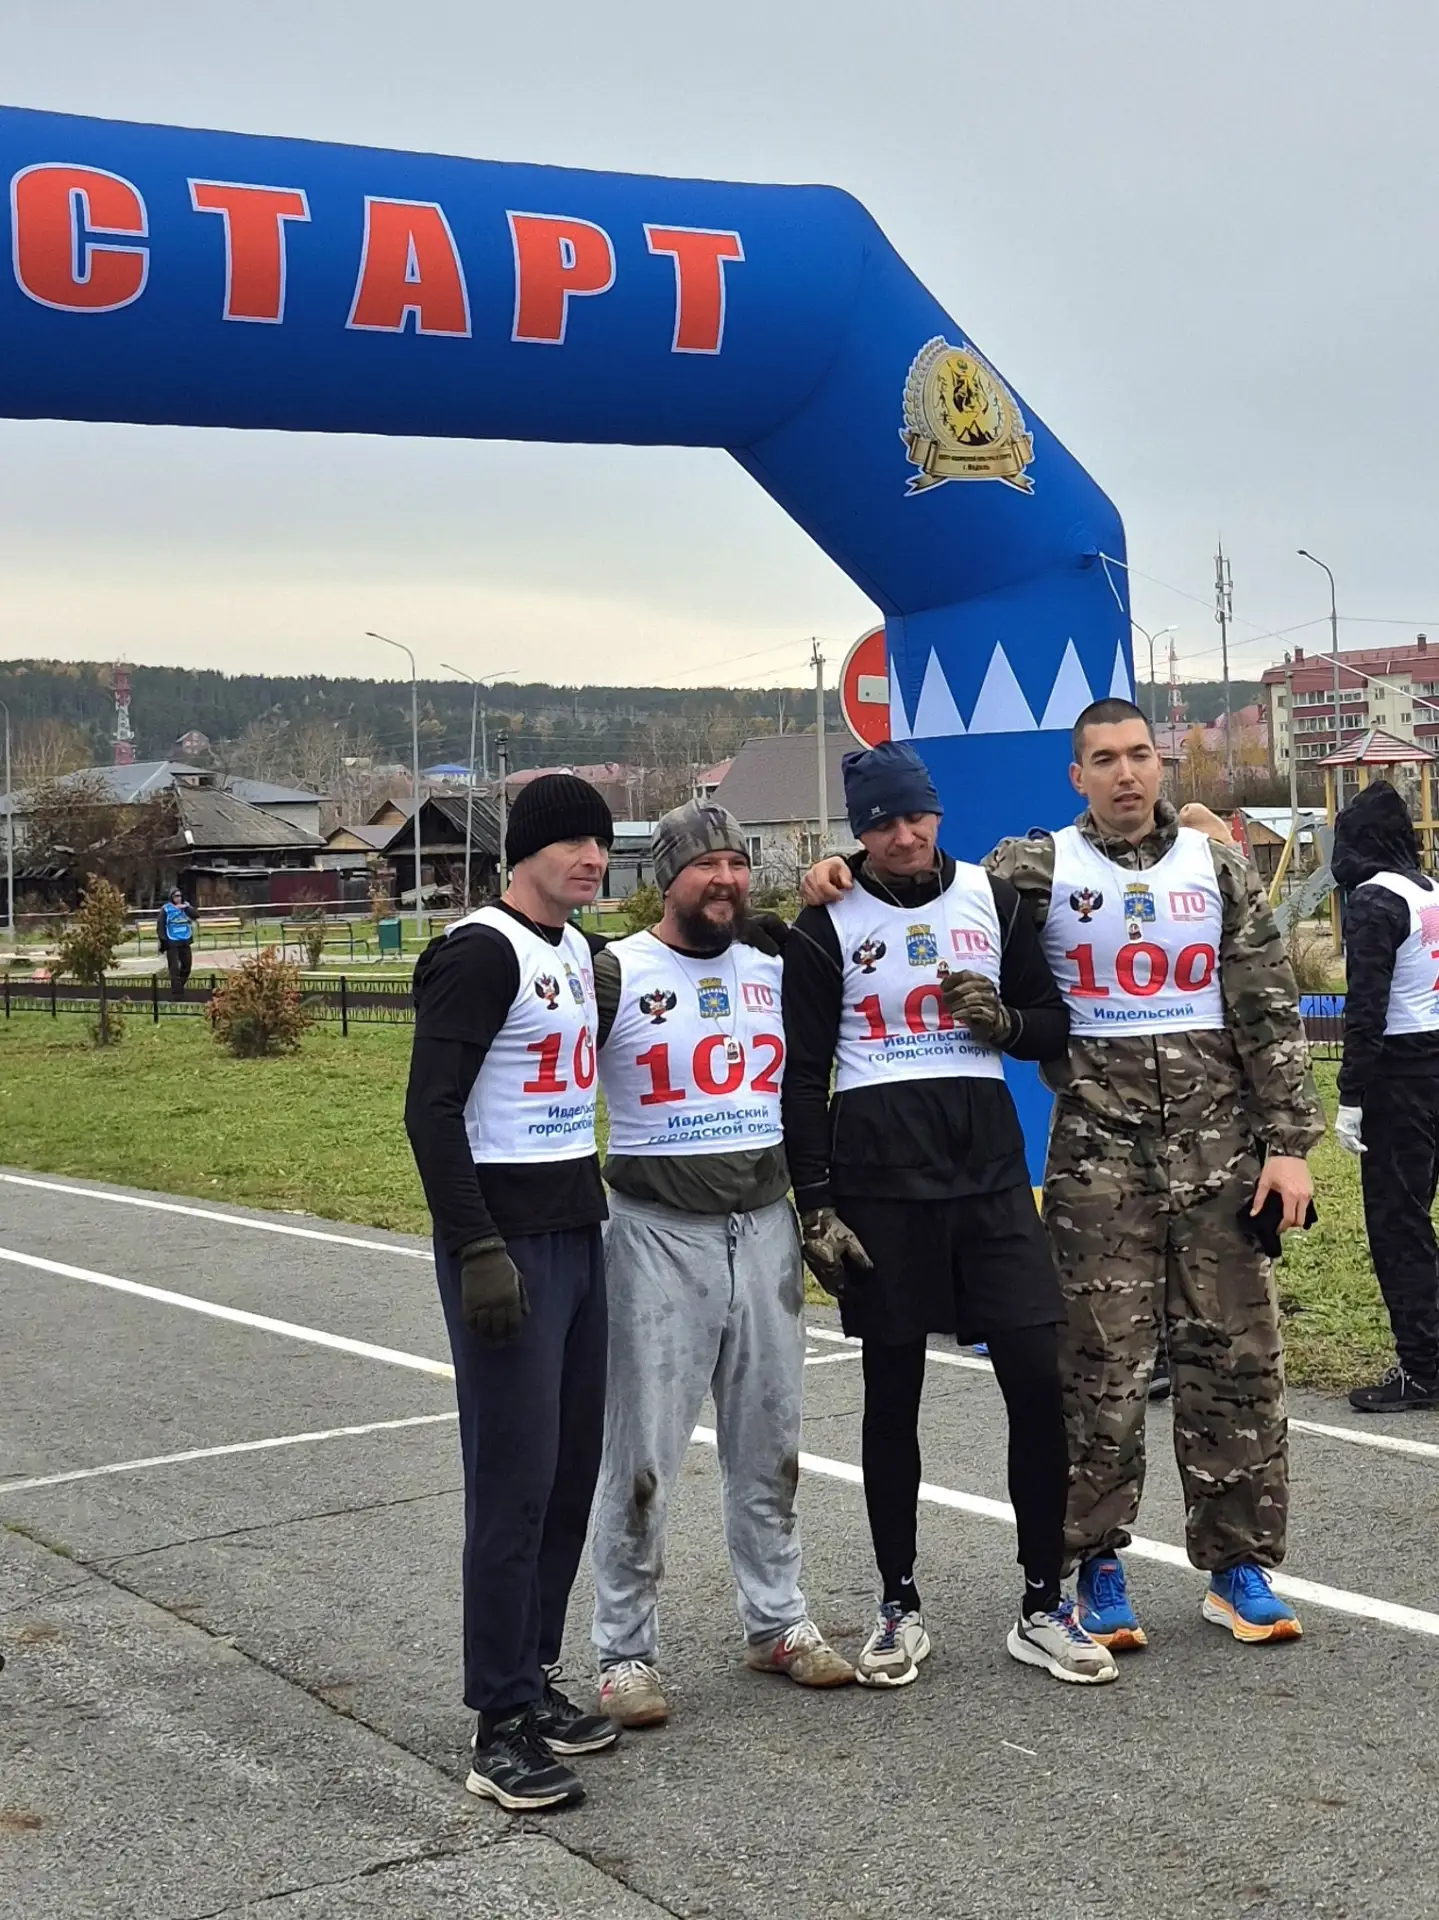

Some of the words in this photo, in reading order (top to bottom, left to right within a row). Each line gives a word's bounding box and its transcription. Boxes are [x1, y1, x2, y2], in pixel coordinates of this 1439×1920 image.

[10, 161, 746, 355] СТАРТ
[1064, 940, 1216, 997] 100
[852, 984, 968, 1041] 10
[1093, 1002, 1195, 1022] Ивдельский
[867, 1043, 954, 1063] городской
[883, 1029, 972, 1048] Ивдельски
[635, 1033, 785, 1106] 102
[667, 1105, 769, 1129] Ивдельский
